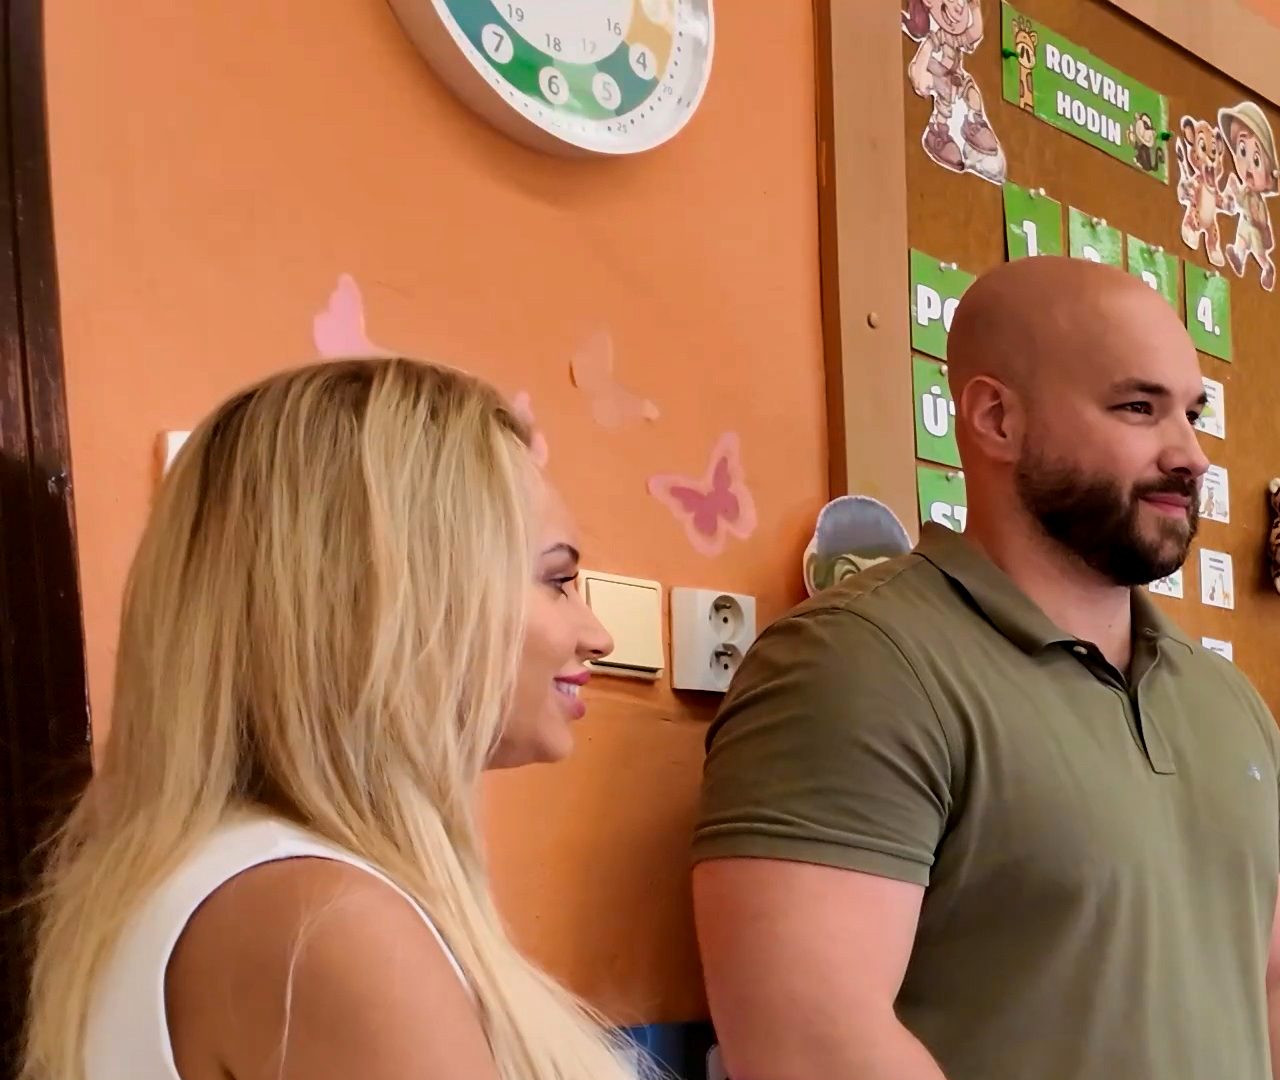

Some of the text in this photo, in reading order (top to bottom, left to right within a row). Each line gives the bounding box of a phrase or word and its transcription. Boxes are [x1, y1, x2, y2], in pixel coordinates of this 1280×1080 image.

[507, 4, 524, 22] 19
[607, 18, 622, 36] 16
[492, 31, 505, 53] 7
[545, 33, 561, 52] 18
[636, 51, 648, 72] 4
[547, 75, 561, 96] 6
[1044, 43, 1130, 112] ROZVRH
[601, 81, 612, 101] 5
[1056, 91, 1121, 147] HODIN
[1196, 296, 1221, 337] 4.
